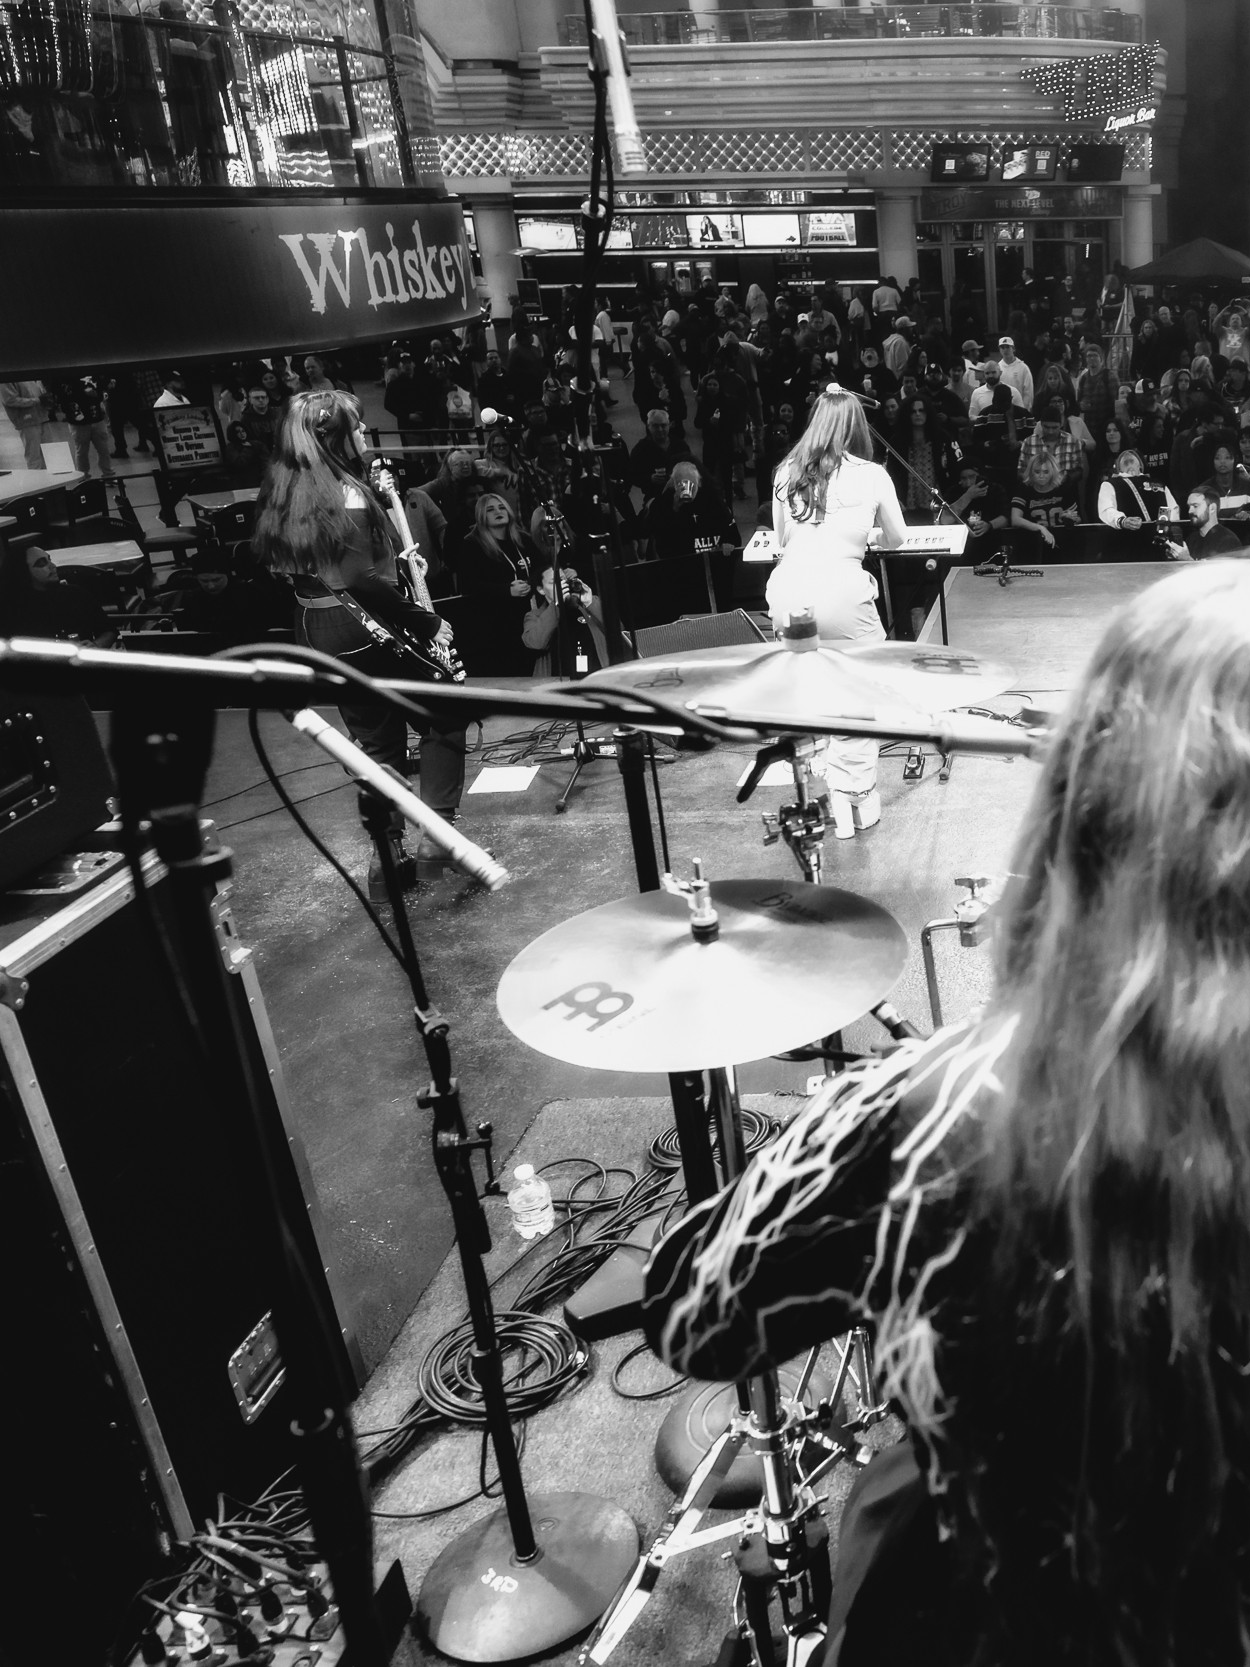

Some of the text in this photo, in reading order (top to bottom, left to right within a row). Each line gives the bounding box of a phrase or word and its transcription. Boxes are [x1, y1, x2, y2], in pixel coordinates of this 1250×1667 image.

[1104, 107, 1157, 132] Liquor Bar
[995, 199, 1009, 209] THE
[1011, 198, 1029, 209] NEXT
[811, 234, 846, 242] FOOTBALL
[278, 219, 468, 316] Whiskey
[694, 537, 713, 549] ALL
[480, 1567, 519, 1594] 3RD
